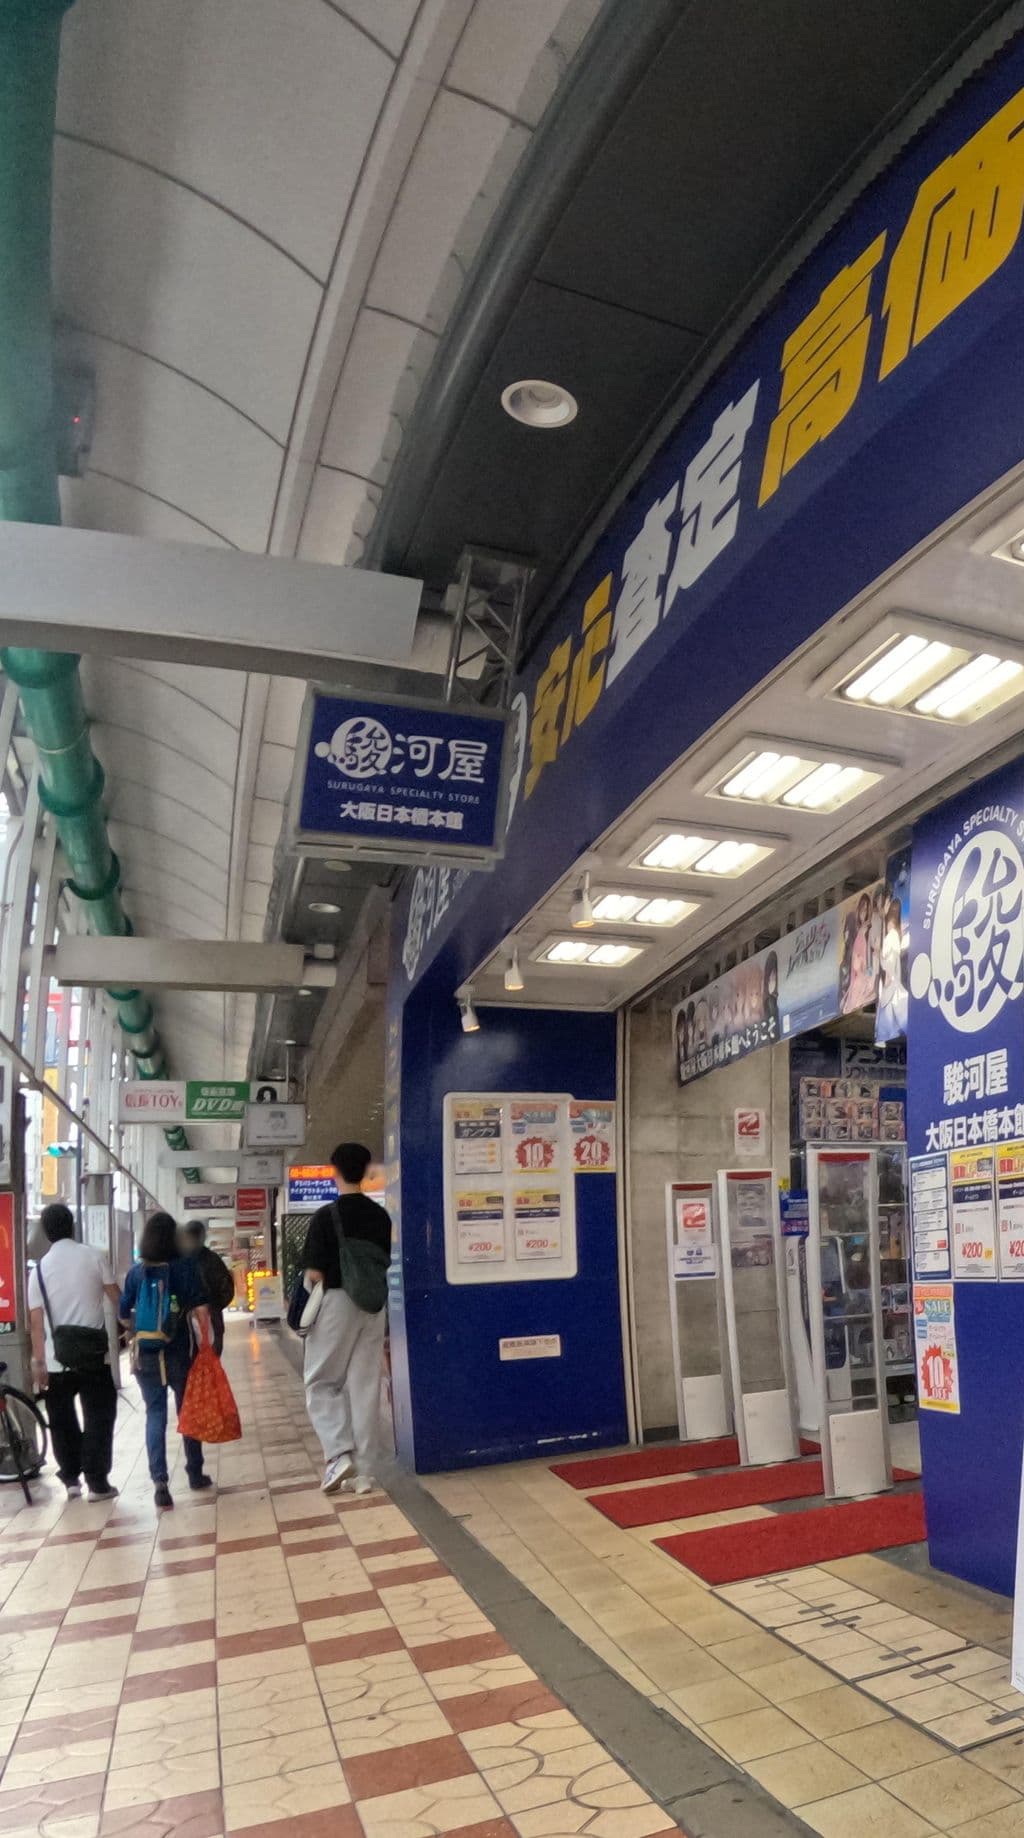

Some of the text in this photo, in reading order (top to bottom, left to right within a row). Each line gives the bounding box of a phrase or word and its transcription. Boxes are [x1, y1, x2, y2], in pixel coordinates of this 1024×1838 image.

[314, 716, 489, 784] 駿河屋
[327, 780, 481, 805] SURUGAYA SPECIALTY STORE
[339, 801, 465, 831] 大阪日本橋本館
[923, 804, 1018, 929] SURUGAYA SPECIALTY
[943, 1048, 1008, 1106] 駿河屋
[961, 1241, 983, 1259] ¥200
